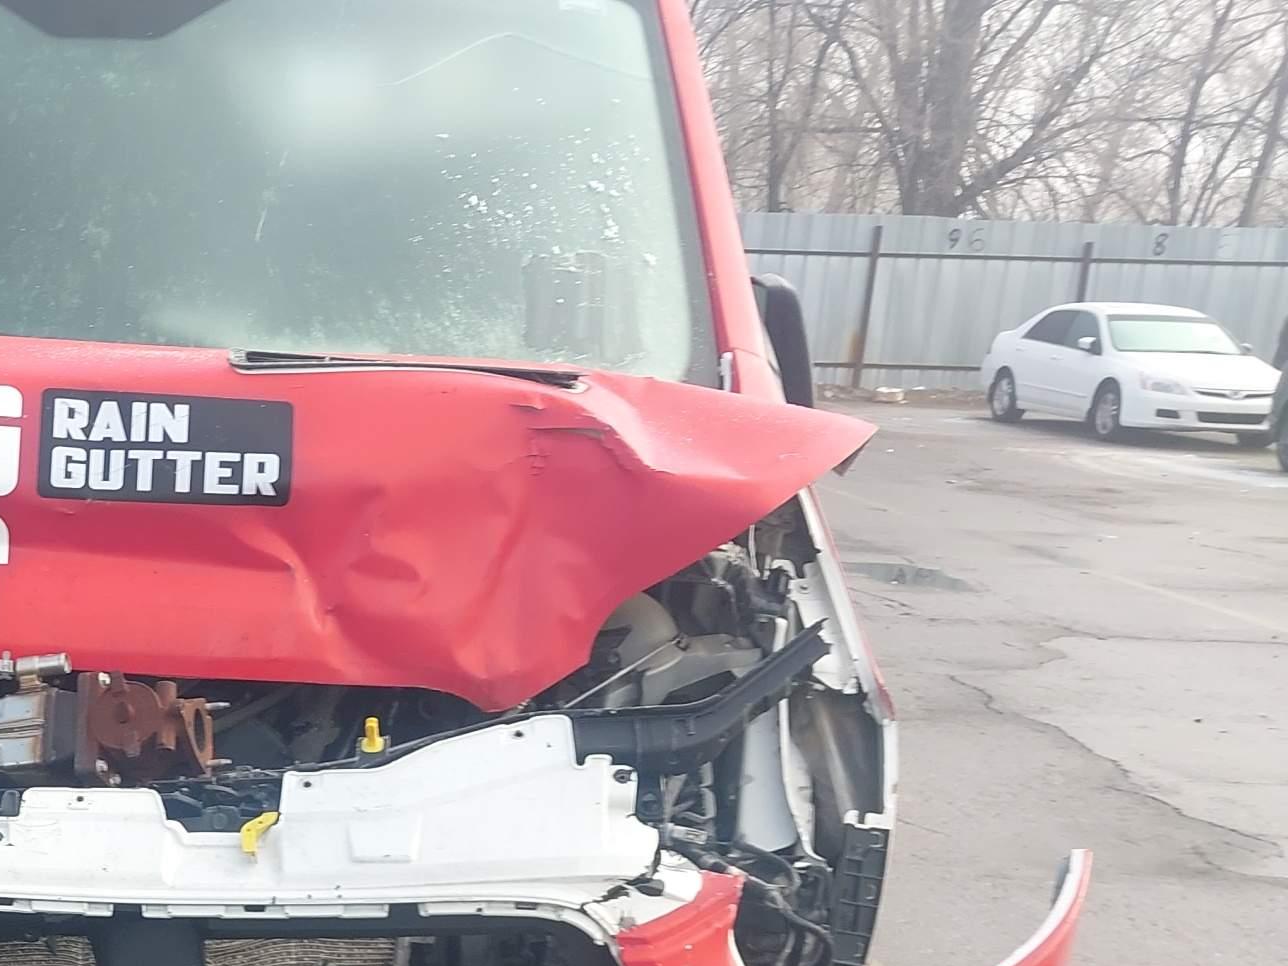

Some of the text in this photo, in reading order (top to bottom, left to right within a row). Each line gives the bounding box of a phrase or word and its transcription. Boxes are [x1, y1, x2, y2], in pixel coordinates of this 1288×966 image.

[1152, 232, 1169, 256] 8
[51, 397, 191, 443] RAIN
[49, 445, 281, 496] GUTTER
